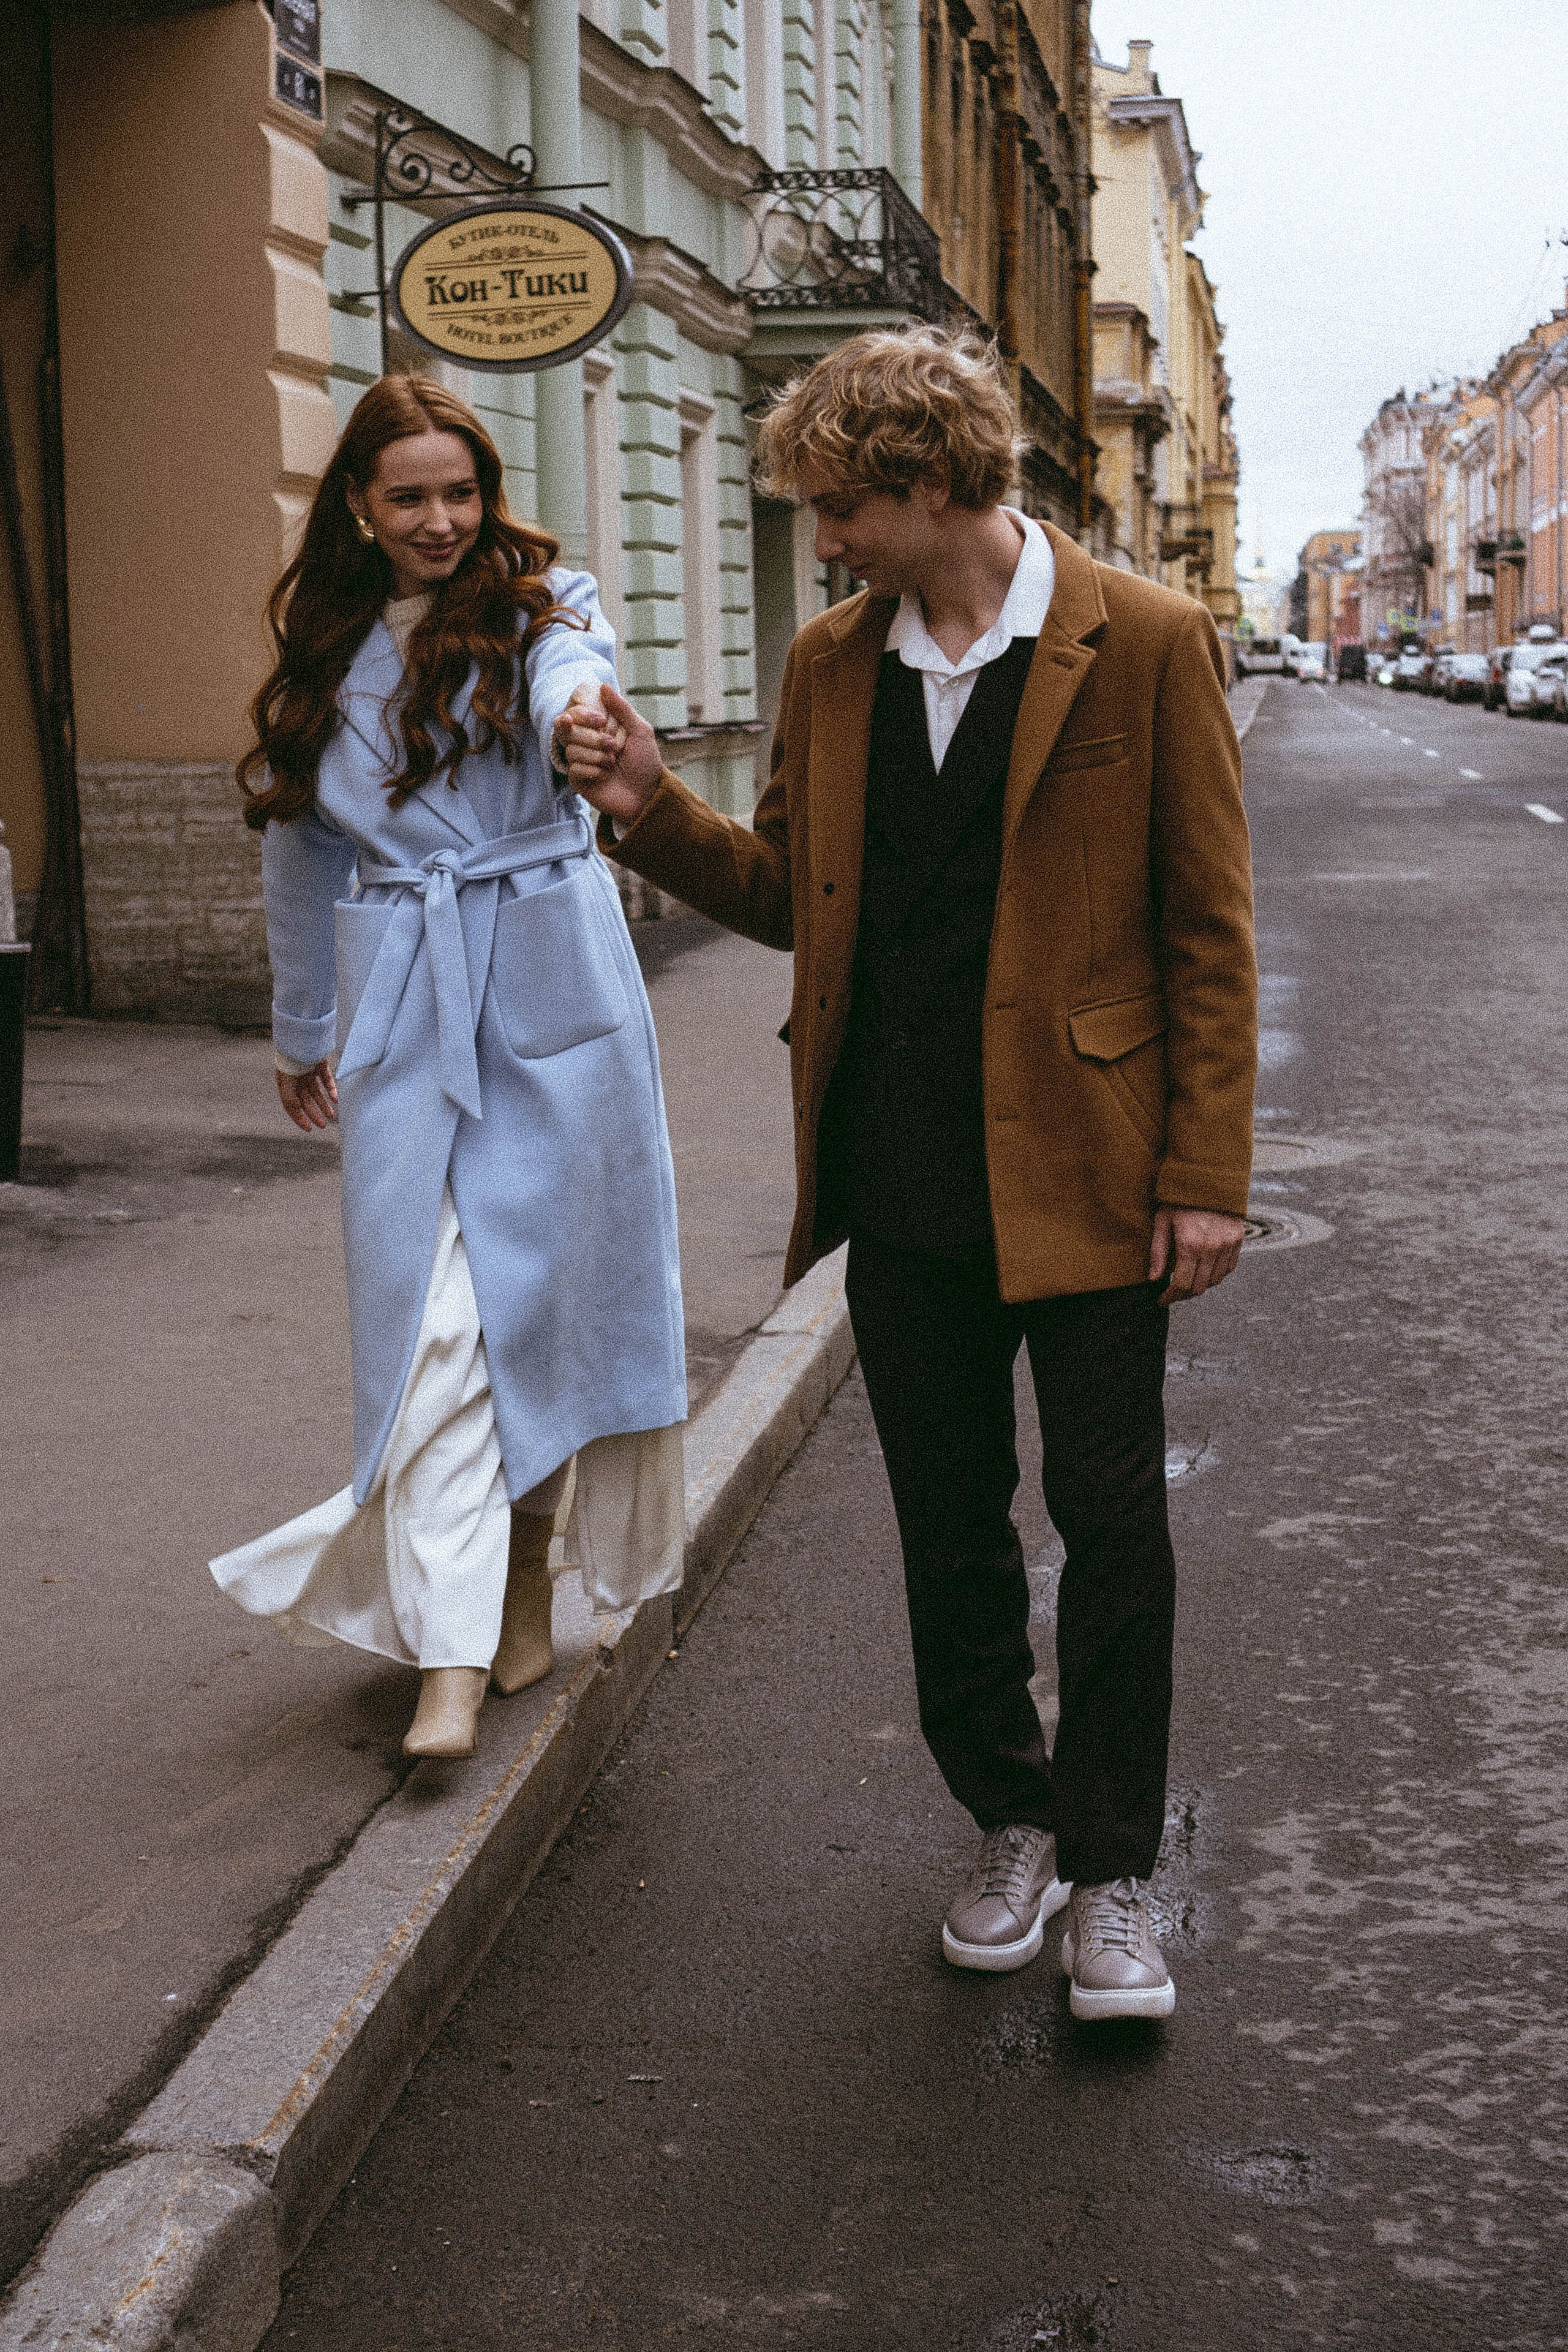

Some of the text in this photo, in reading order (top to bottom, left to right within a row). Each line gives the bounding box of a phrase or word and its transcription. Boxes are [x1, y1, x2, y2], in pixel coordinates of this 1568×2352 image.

[448, 224, 560, 250] БУТИК-ОТЕЛЬ
[424, 270, 588, 306] Кон-Тики
[446, 313, 575, 345] HOTEL BOUTIQUE
